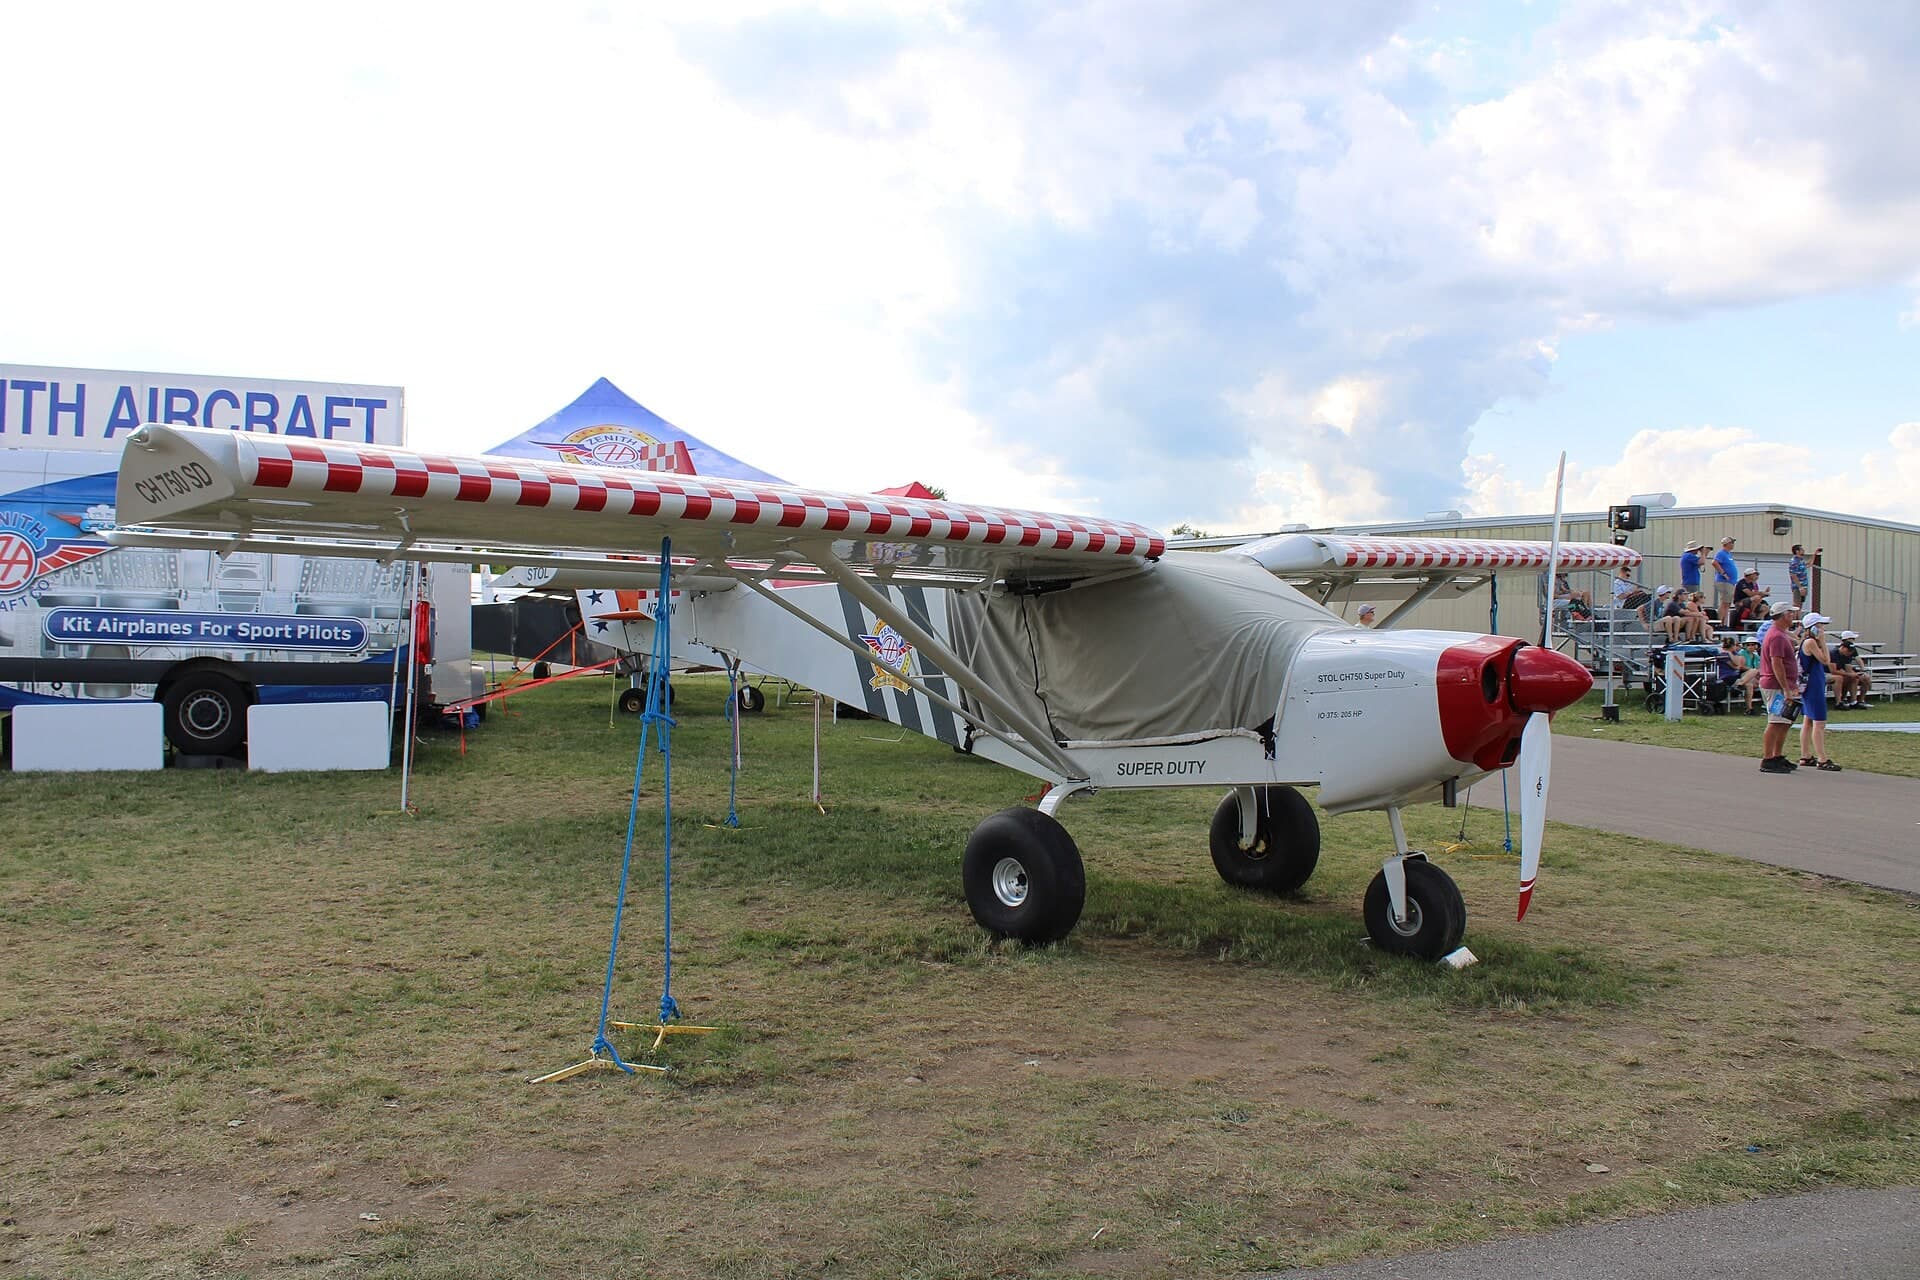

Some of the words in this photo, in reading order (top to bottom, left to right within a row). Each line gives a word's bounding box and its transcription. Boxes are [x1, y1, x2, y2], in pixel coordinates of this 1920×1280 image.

[104, 386, 387, 444] AIRCRAFT
[587, 435, 638, 446] ZENITH
[135, 478, 167, 504] CH
[155, 470, 191, 497] 750
[181, 462, 213, 488] SD
[527, 567, 549, 581] STOL
[62, 617, 92, 633] Kit
[97, 618, 193, 637] Airplanes
[200, 621, 232, 636] For
[237, 622, 292, 641] Sport
[297, 624, 352, 640] Pilots
[1318, 674, 1338, 682] STOL
[1340, 672, 1363, 681] CH750
[1364, 671, 1386, 680] Super
[1387, 670, 1405, 679] Duty
[1117, 762, 1164, 775] SUPER
[1167, 760, 1207, 774] DUTY
